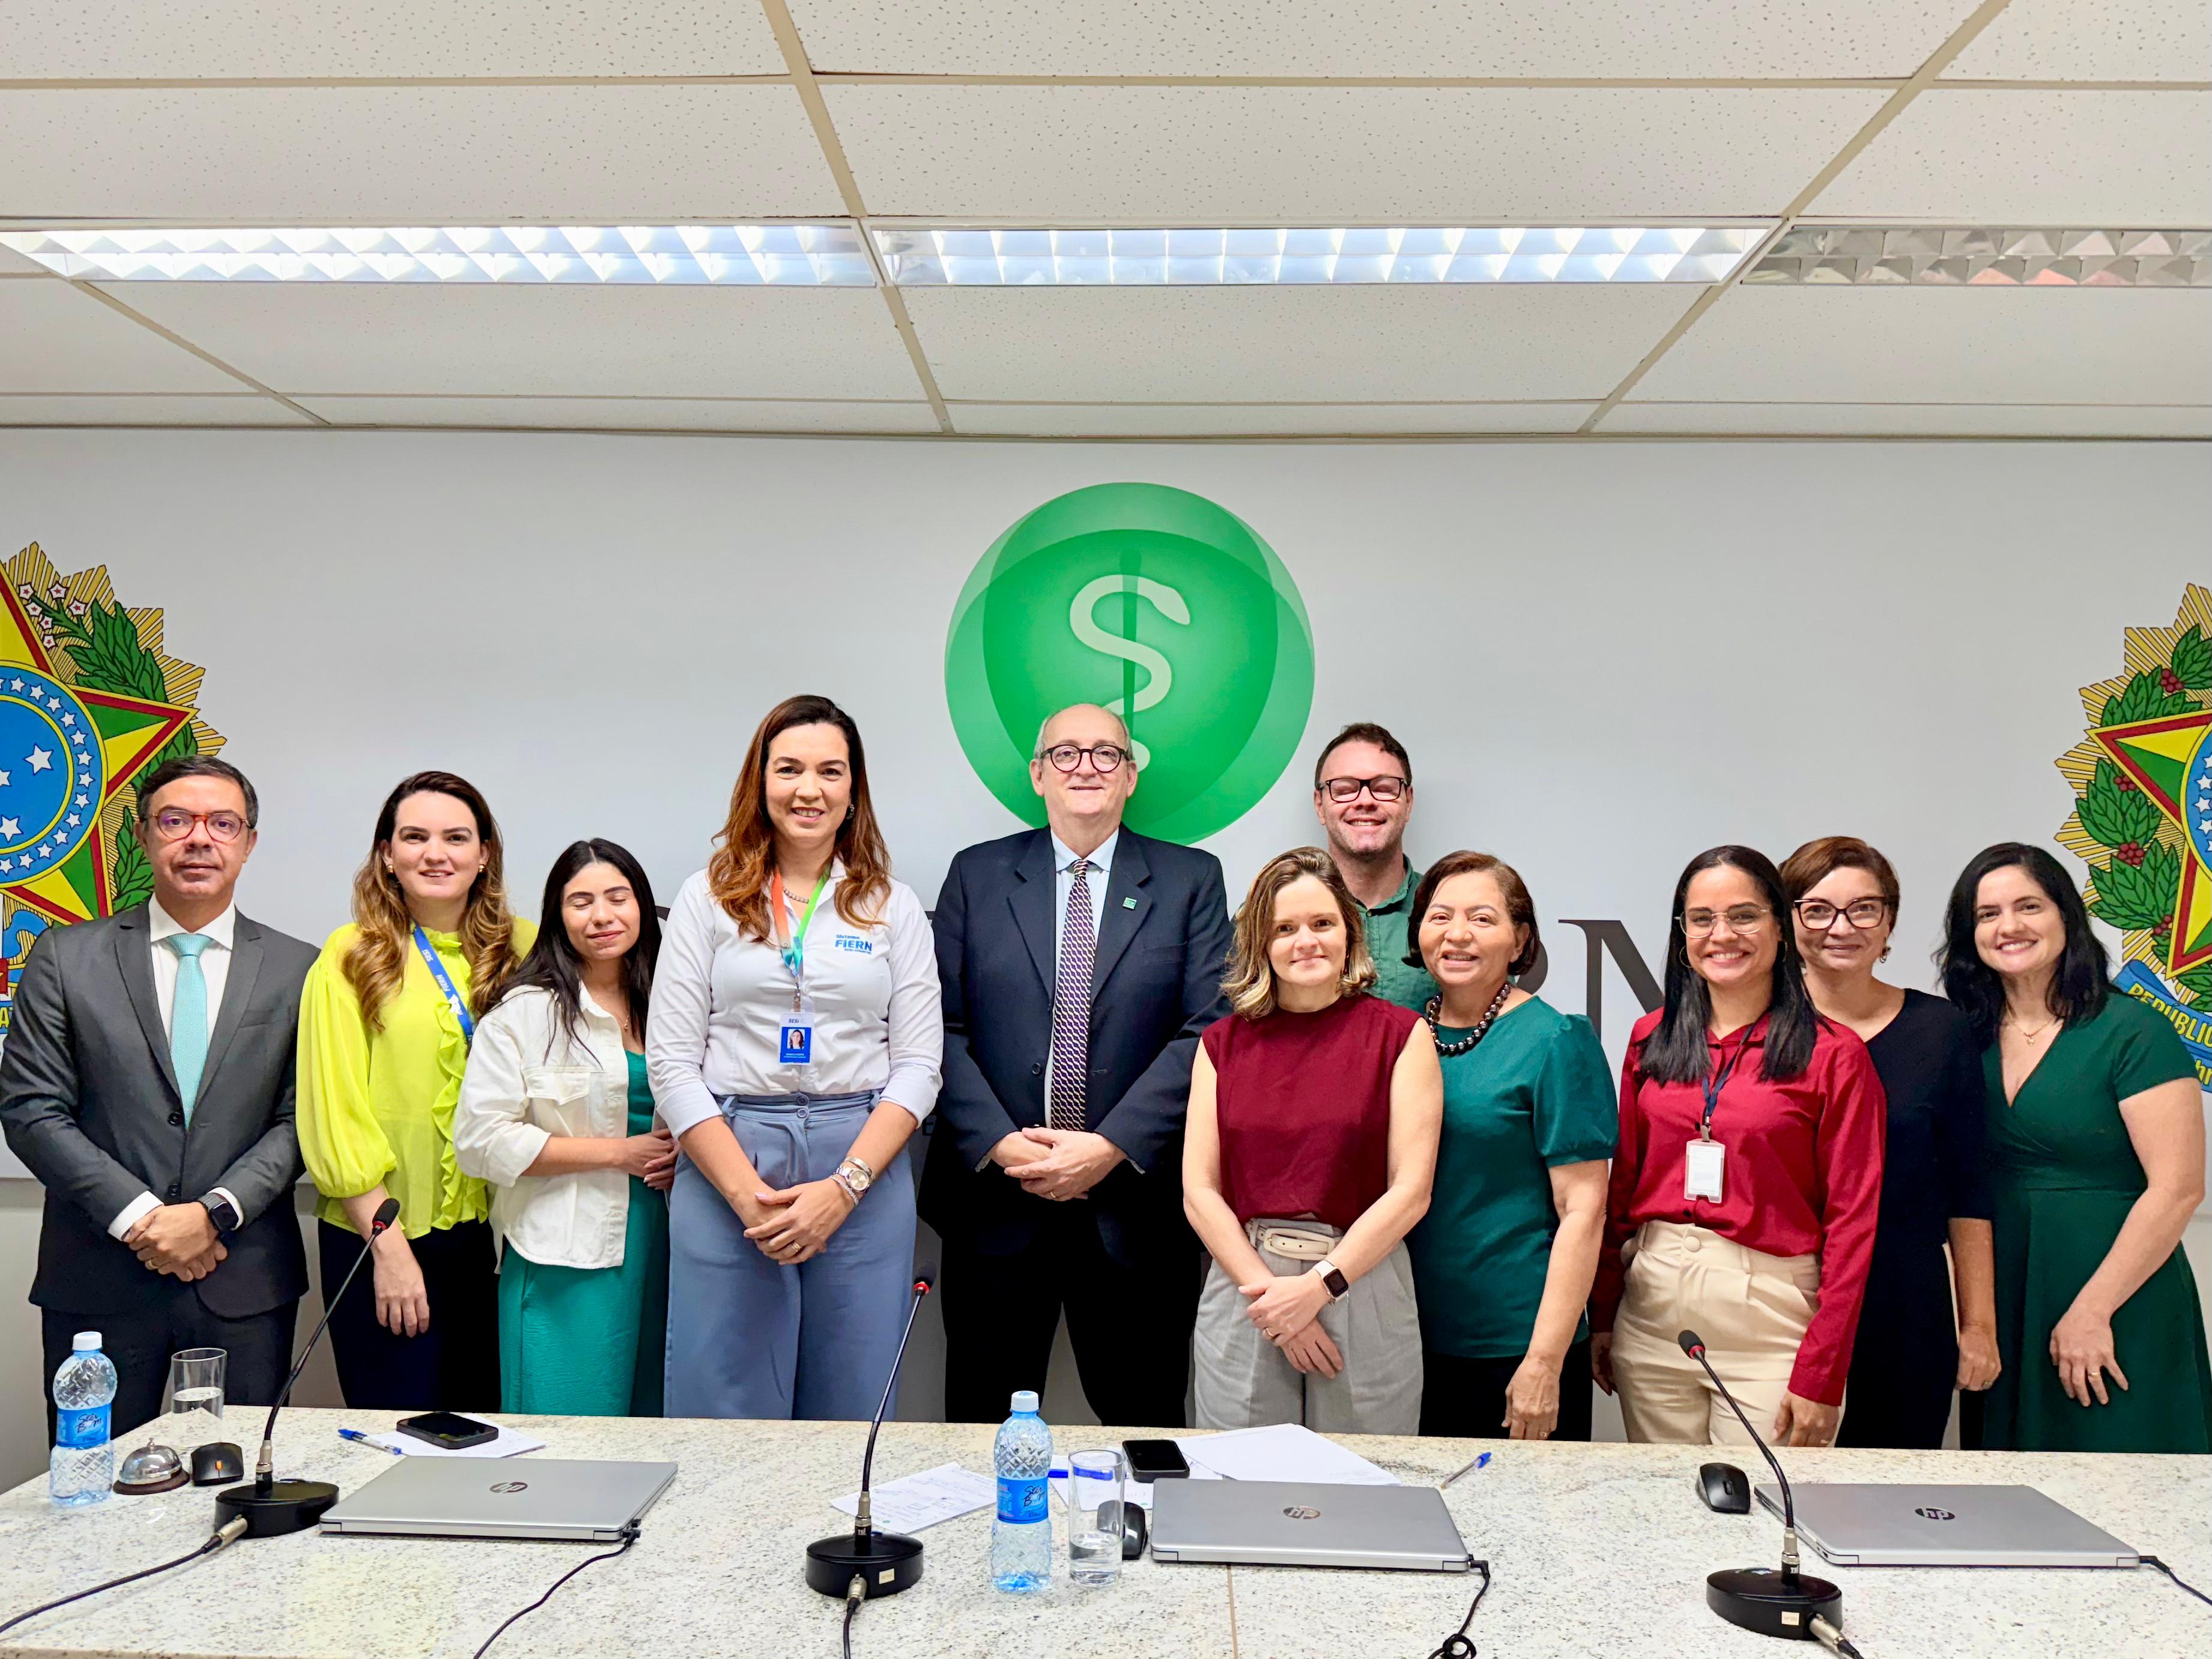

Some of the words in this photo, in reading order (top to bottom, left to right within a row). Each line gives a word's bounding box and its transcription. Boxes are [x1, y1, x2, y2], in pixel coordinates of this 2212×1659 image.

[835, 939, 872, 951] FIERN
[435, 974, 450, 992] FIERN
[491, 1481, 526, 1494] hp
[1285, 1505, 1319, 1520] hp
[1917, 1506, 1953, 1520] hp
